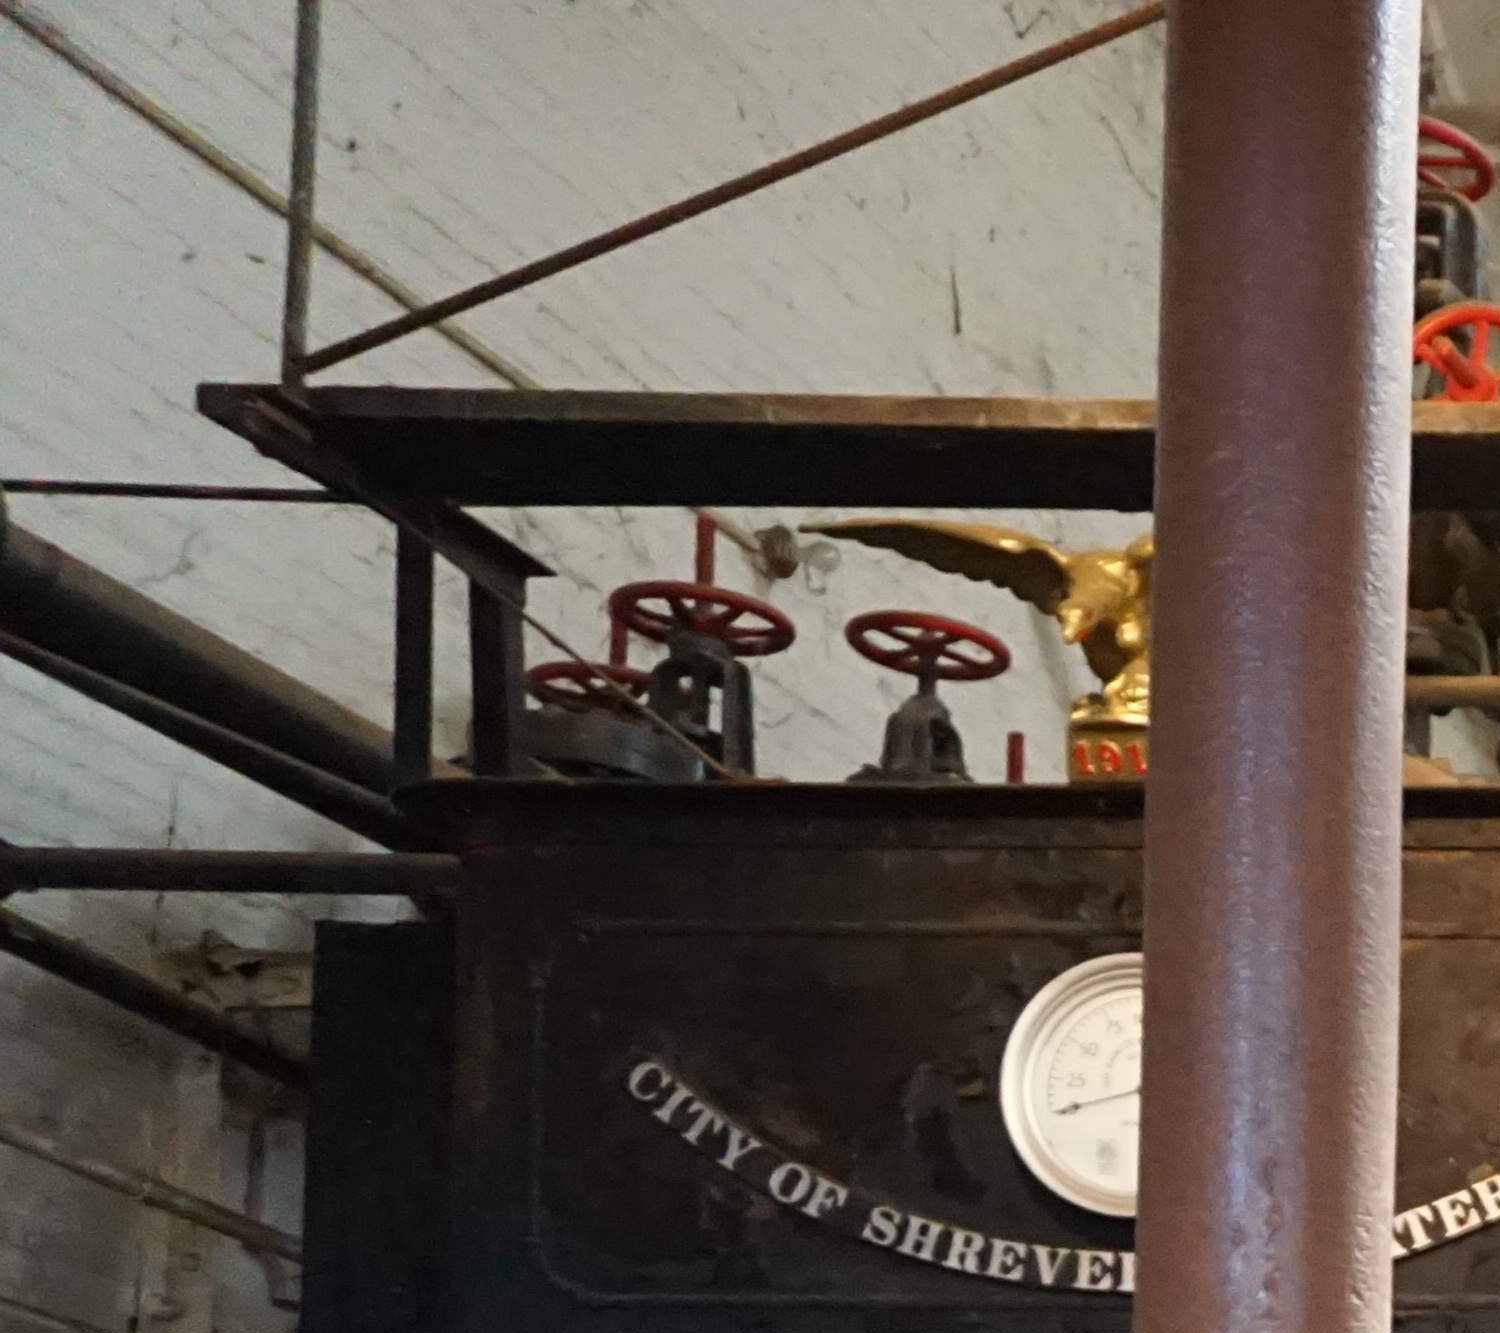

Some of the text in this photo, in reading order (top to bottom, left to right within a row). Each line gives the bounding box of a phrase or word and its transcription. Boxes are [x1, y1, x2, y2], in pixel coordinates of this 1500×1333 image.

[1080, 1042, 1099, 1057] 50
[1066, 1073, 1086, 1088] 25
[627, 1060, 749, 1169] CITY
[770, 1163, 847, 1218] OF
